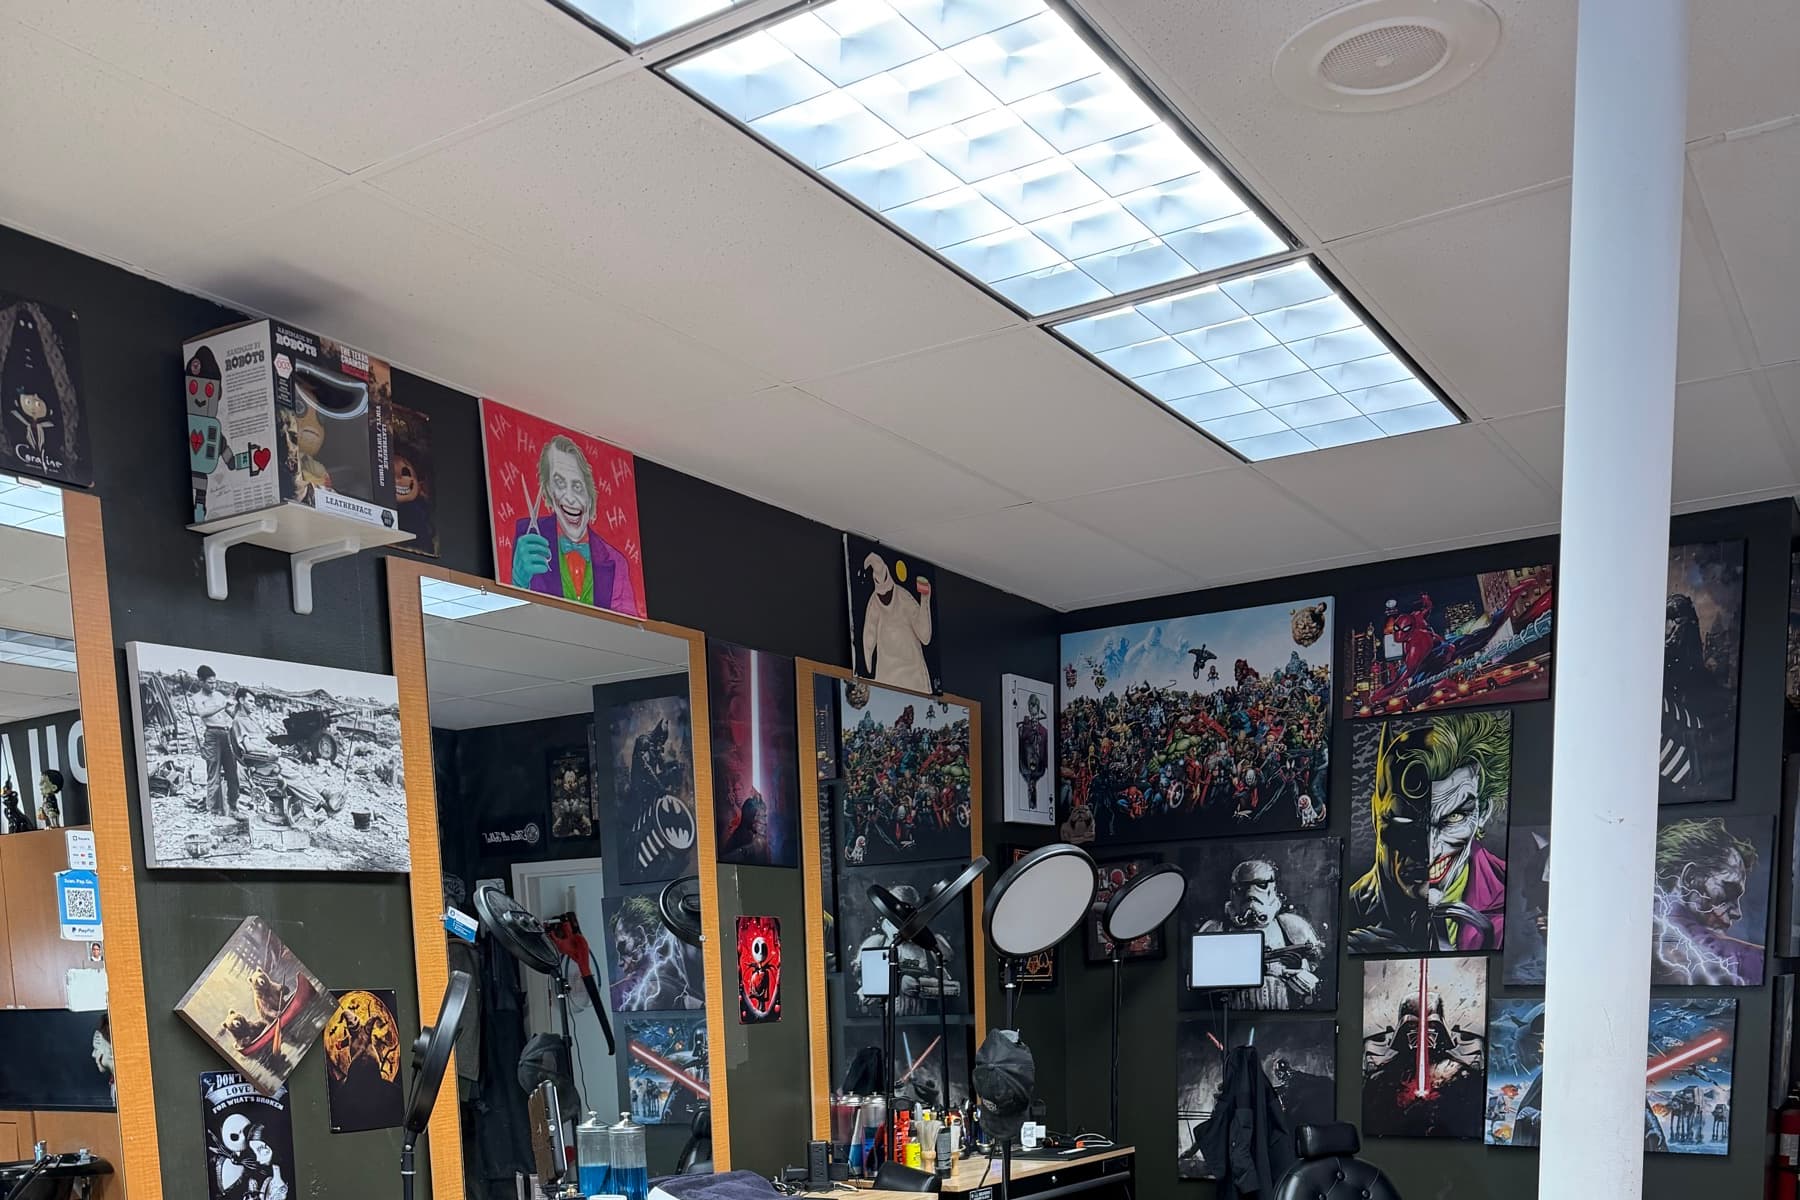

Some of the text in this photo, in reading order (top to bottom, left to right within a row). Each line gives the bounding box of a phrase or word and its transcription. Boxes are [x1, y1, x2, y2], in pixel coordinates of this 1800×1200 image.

[275, 333, 317, 357] ROBOTS
[225, 350, 265, 371] ROBOTS
[490, 414, 511, 440] HA
[516, 426, 537, 454] HA
[585, 440, 599, 458] HA
[500, 461, 520, 492] HA
[611, 456, 632, 487] HA
[599, 477, 612, 495] HA
[325, 496, 372, 516] LEATHERFACE
[498, 502, 515, 522] HA
[606, 505, 627, 530] HA
[499, 536, 512, 549] HA
[624, 539, 640, 564] HA
[226, 1085, 251, 1096] LOVE
[212, 1096, 284, 1114] FOR WHAT'S BROKEN
